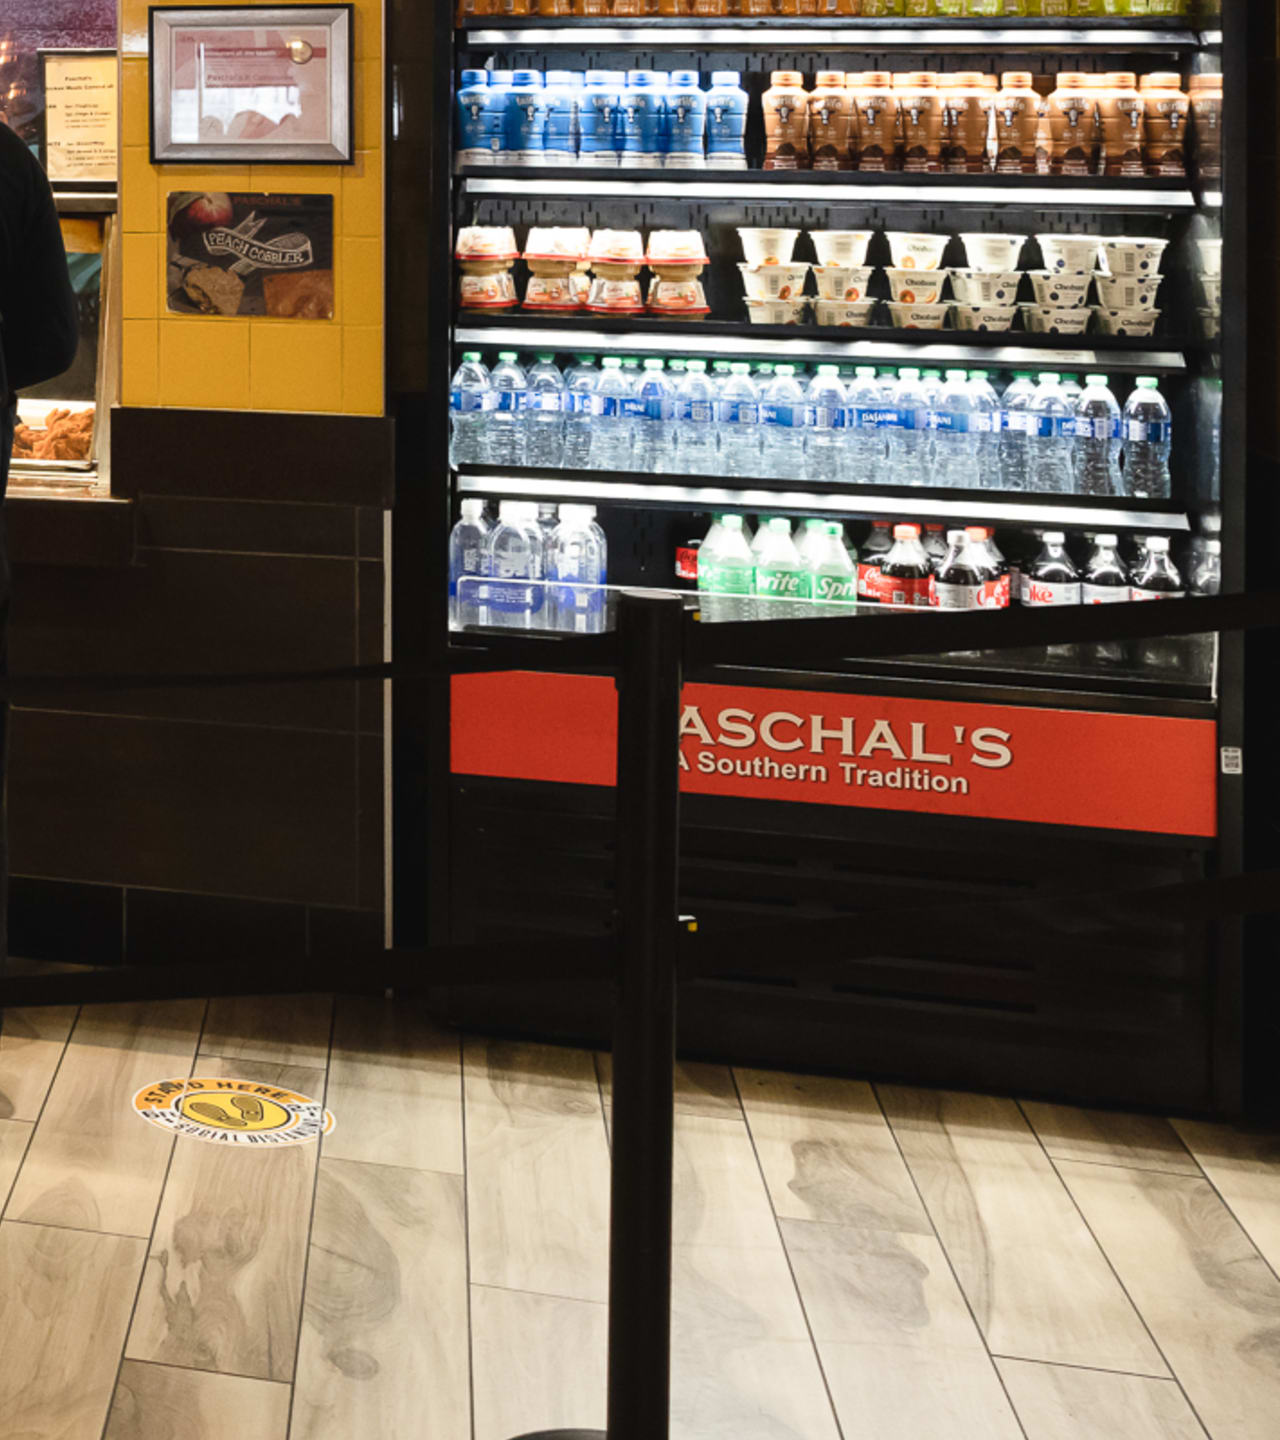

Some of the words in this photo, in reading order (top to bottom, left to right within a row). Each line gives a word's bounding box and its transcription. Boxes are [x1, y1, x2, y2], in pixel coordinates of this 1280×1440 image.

[208, 232, 250, 255] PEACH
[248, 246, 304, 264] COBBLER
[679, 704, 1013, 769] ASCHAL'S
[697, 751, 828, 783] Southern
[839, 762, 970, 795] Tradition
[144, 1081, 205, 1105] STAND
[216, 1081, 289, 1101] HERE
[173, 1123, 240, 1142] SOCIAL
